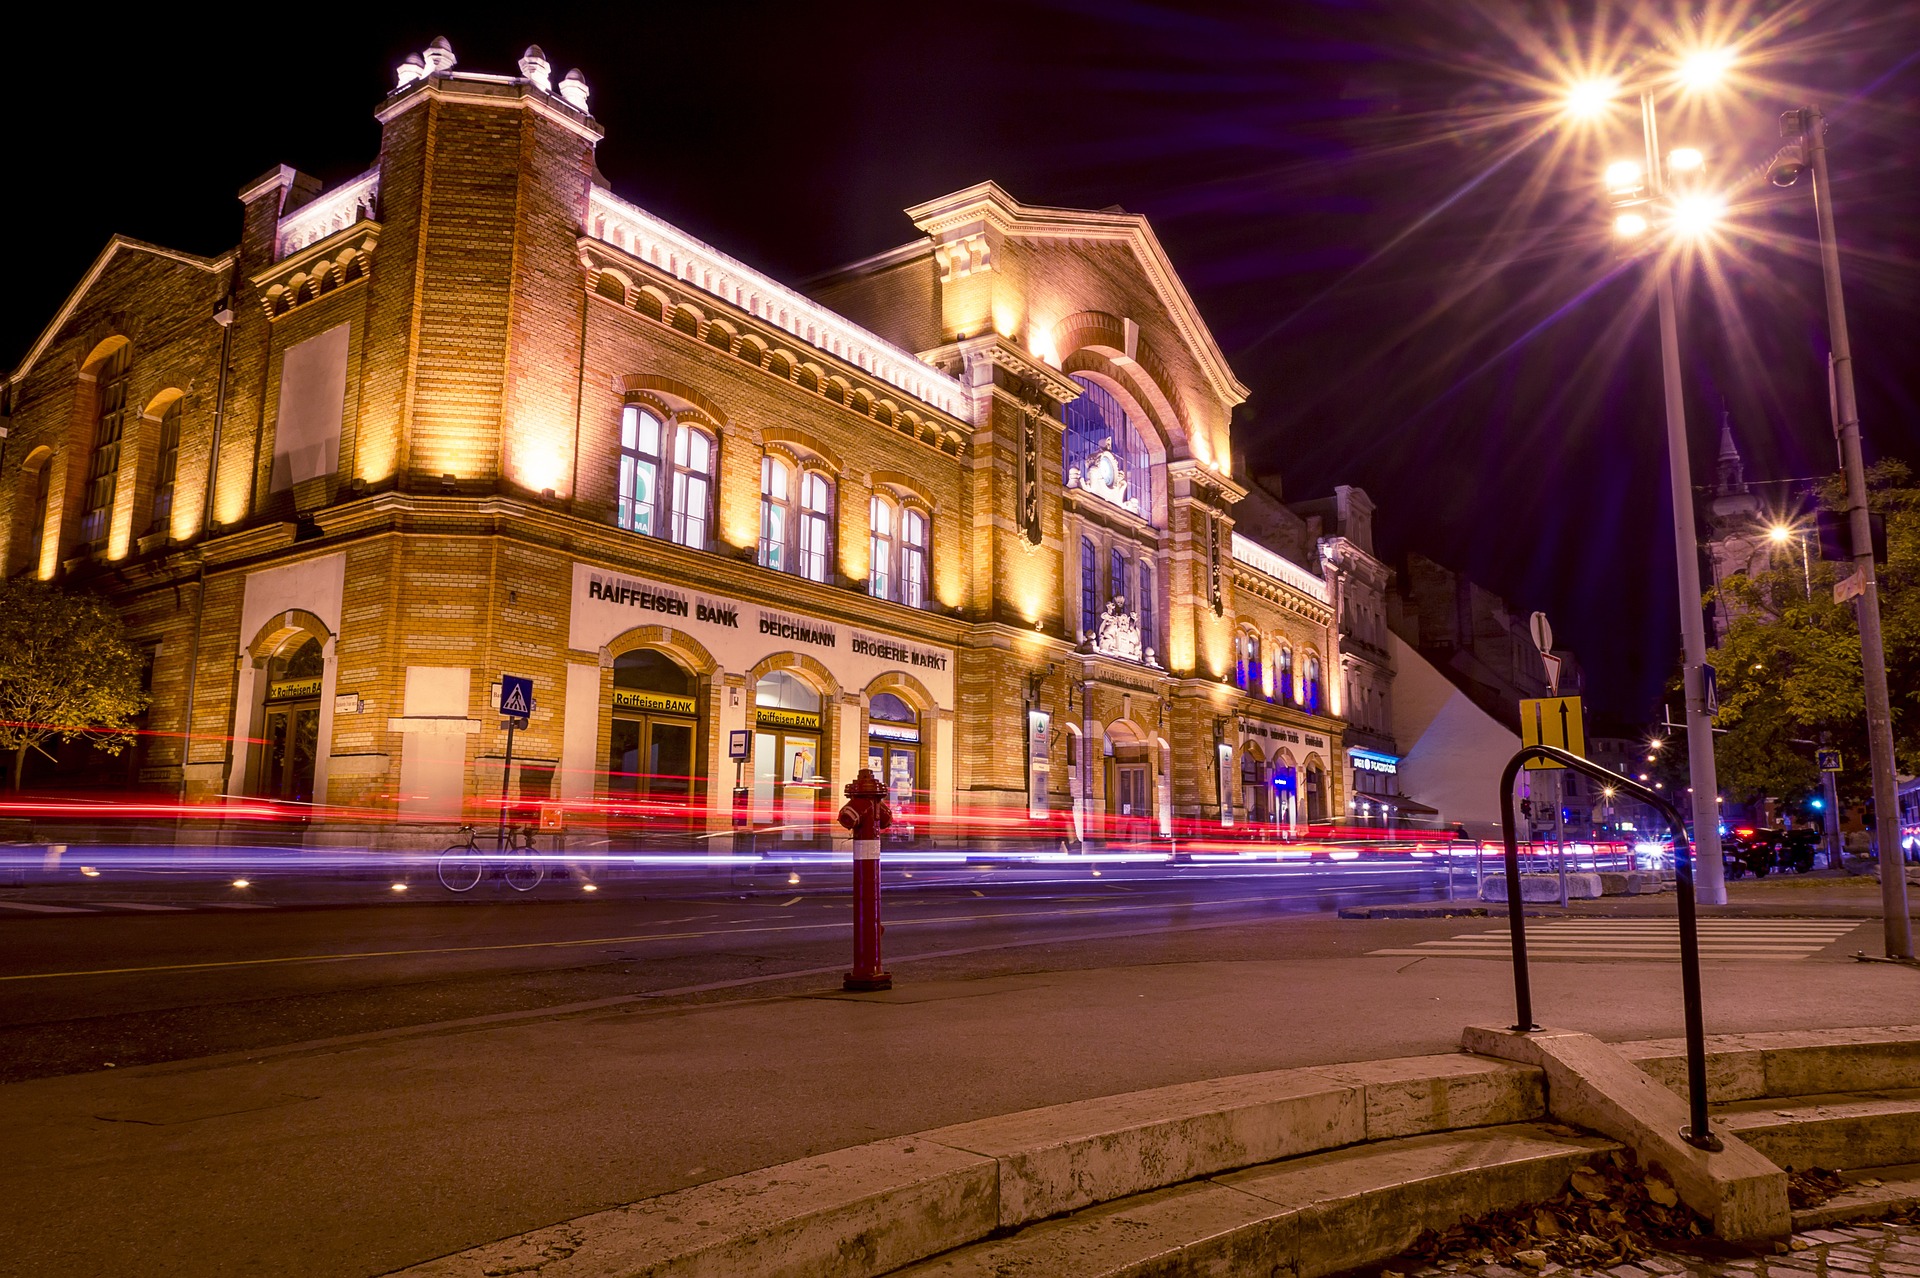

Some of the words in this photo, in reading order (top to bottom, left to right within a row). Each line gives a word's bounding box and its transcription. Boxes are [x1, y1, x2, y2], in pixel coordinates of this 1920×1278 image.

[589, 580, 689, 618] RAIFFEISEN
[695, 604, 739, 628] BANK
[759, 619, 836, 648] DEICHMANN
[852, 638, 909, 664] DROGERIE
[911, 652, 948, 672] MARKT
[277, 684, 311, 698] Raiffeisen
[616, 693, 664, 709] Raiffeisen
[665, 699, 692, 712] BANK
[757, 711, 795, 725] Raiffeisen
[795, 715, 817, 727] BANK
